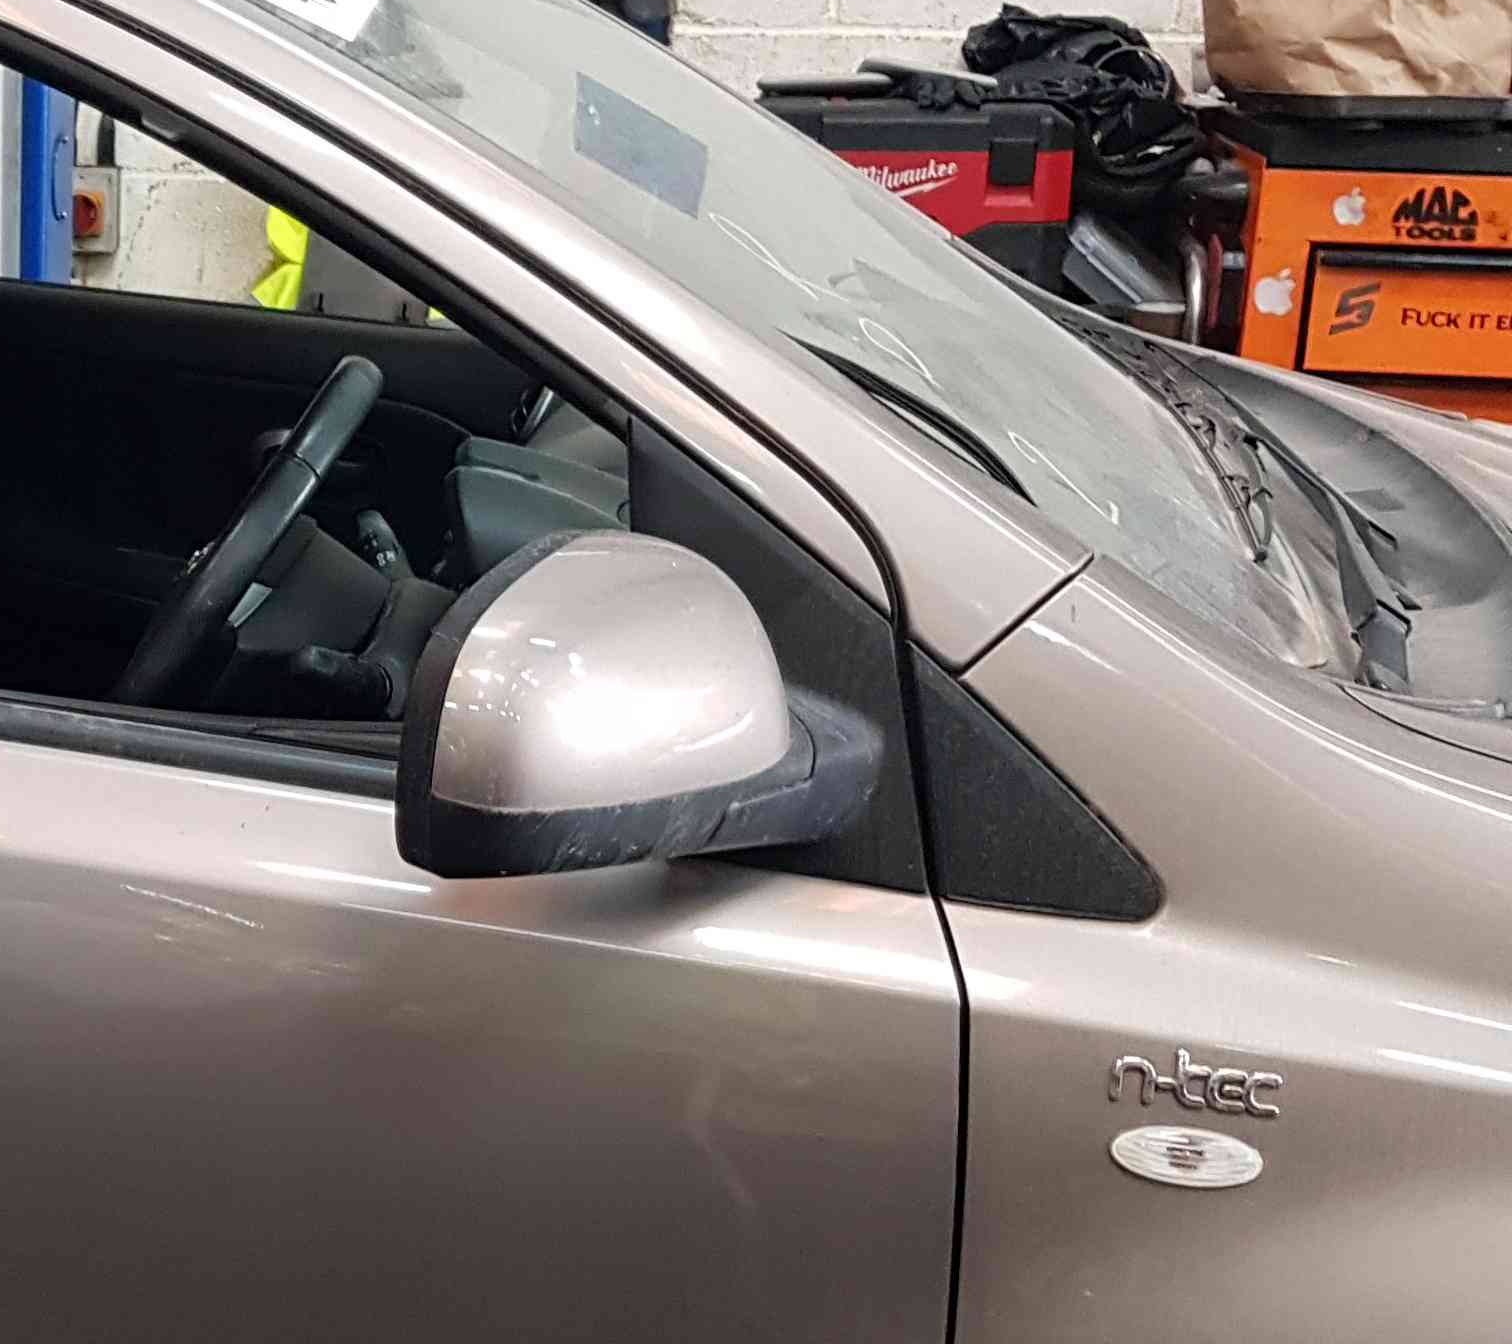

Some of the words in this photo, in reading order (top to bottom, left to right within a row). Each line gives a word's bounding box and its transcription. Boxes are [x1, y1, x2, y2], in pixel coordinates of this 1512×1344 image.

[1392, 186, 1479, 226] MAC
[1392, 225, 1477, 242] TOOLS
[1400, 307, 1463, 329] FUCK
[1469, 313, 1491, 329] IT
